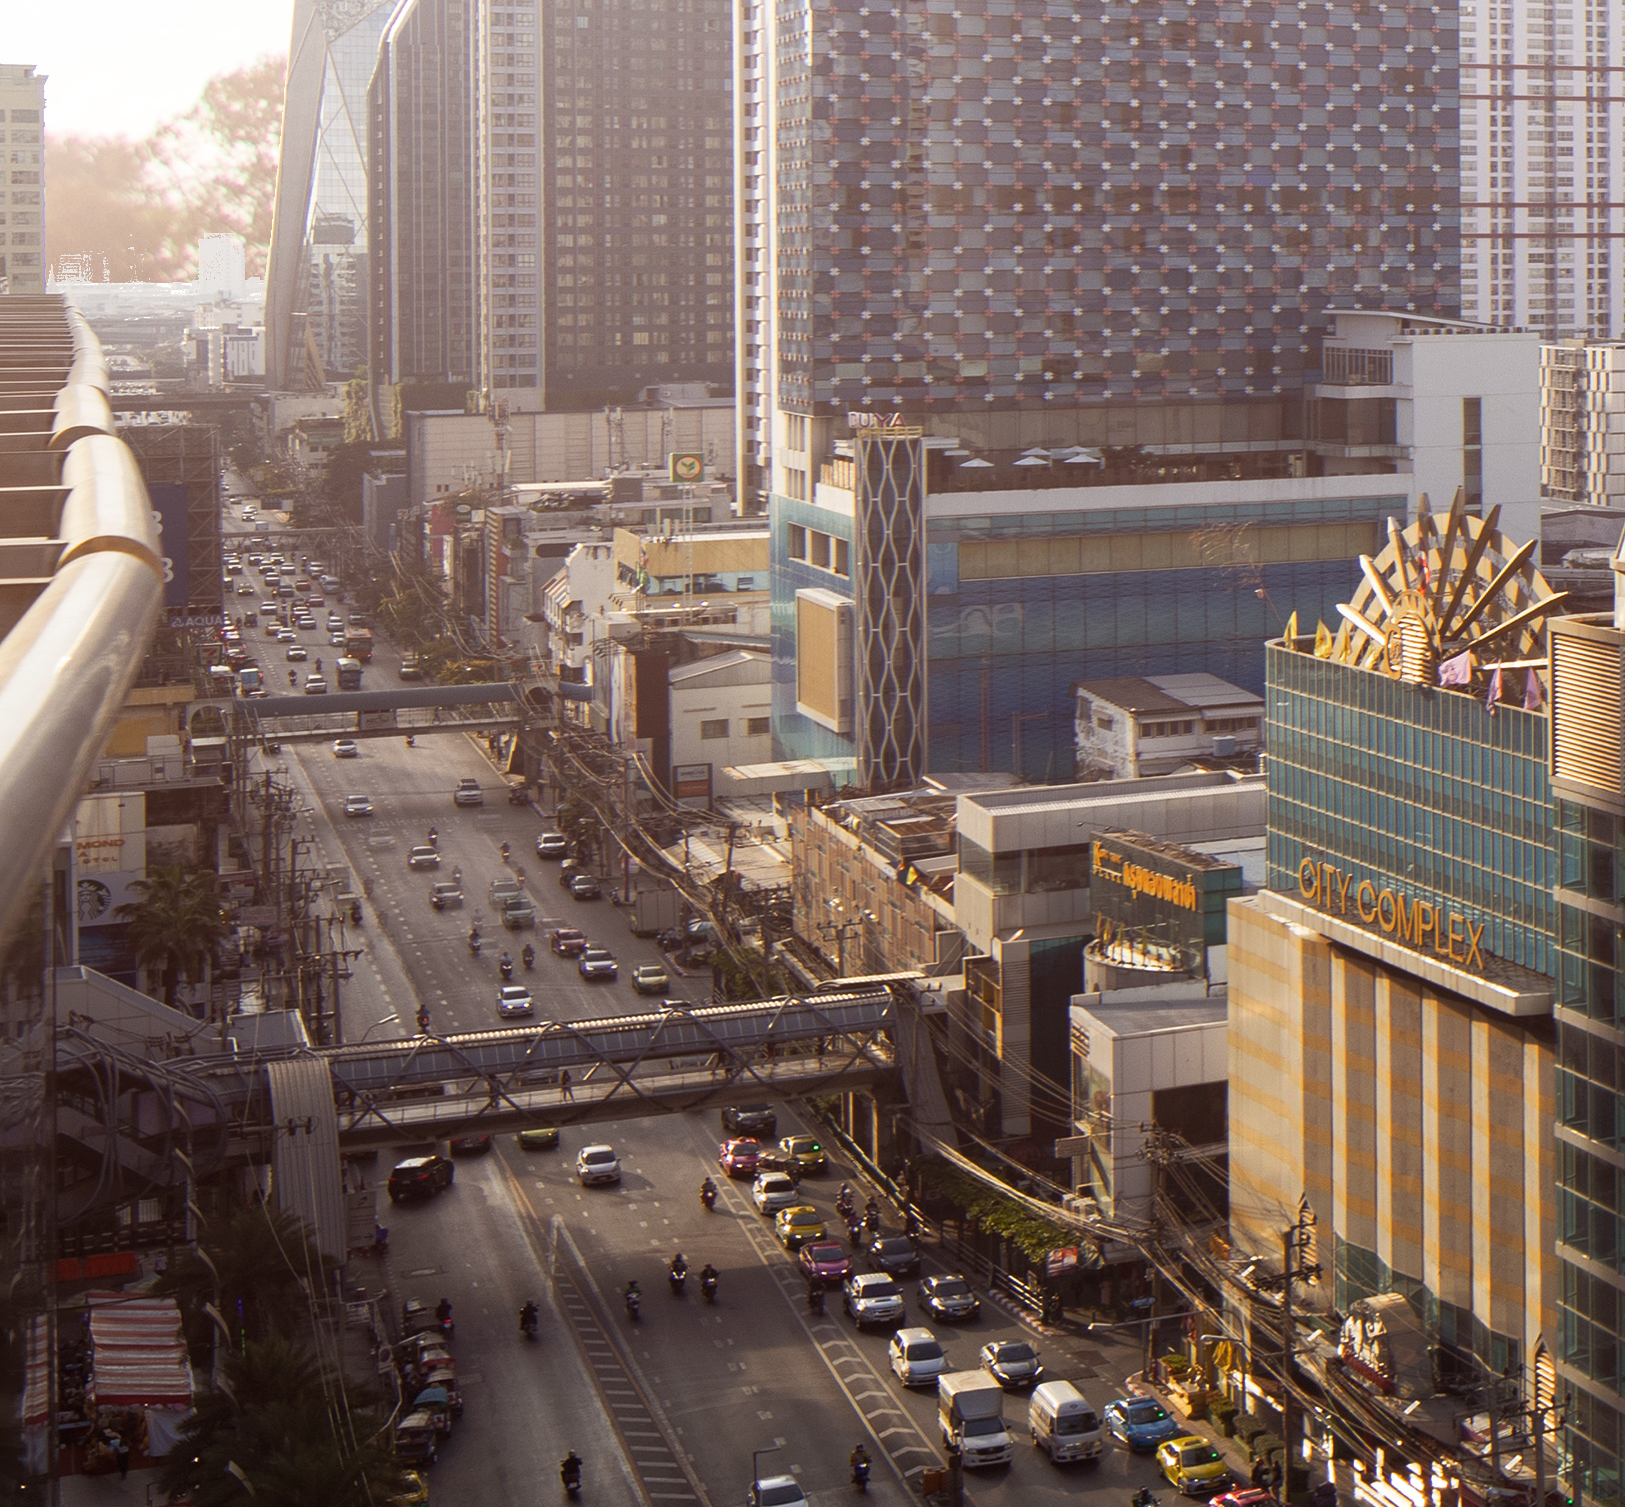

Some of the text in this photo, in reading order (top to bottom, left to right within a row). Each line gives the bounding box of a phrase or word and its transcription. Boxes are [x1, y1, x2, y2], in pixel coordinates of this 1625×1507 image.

[77, 839, 125, 850] MOND
[1299, 857, 1485, 970] CITY COMPLEX
